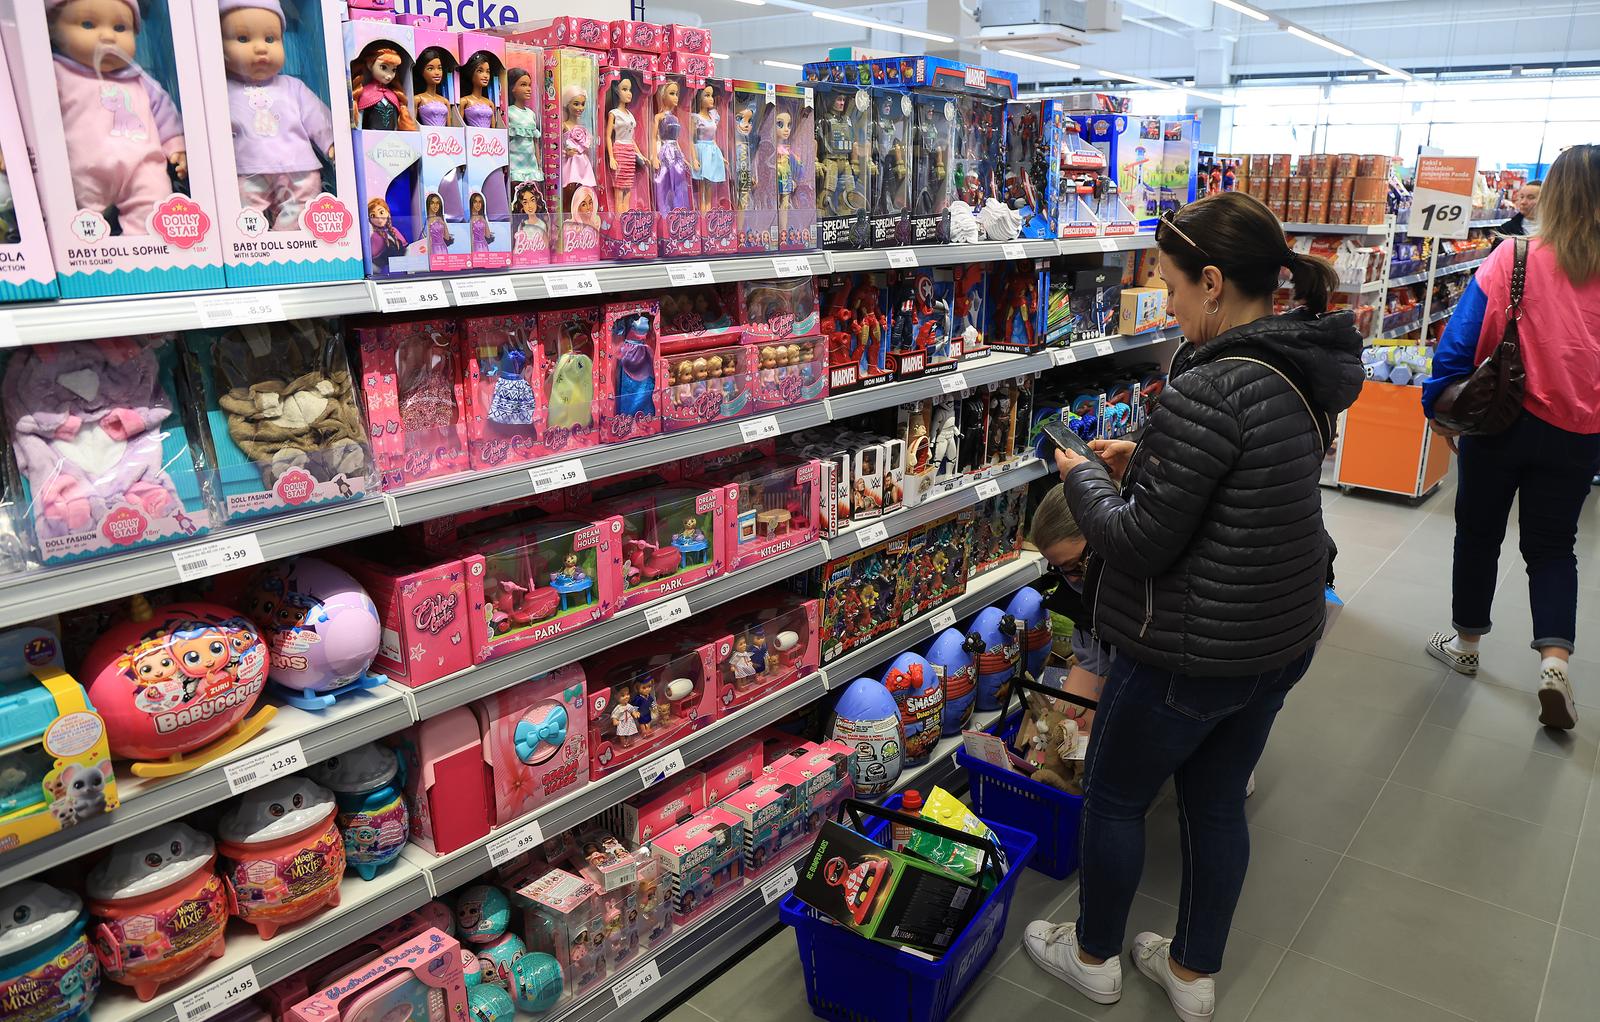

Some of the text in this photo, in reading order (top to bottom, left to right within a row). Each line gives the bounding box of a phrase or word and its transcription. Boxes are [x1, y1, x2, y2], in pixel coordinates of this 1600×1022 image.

[965, 67, 987, 87] MARVEL
[427, 133, 462, 156] Barbie
[472, 135, 505, 157] Barbie
[376, 149, 411, 159] FROZEN
[161, 213, 200, 226] DOLLY
[312, 212, 344, 223] DOLLY
[916, 218, 937, 229] SPECIAL
[80, 220, 97, 228] TRY
[317, 222, 343, 233] STAR
[823, 219, 850, 231] SPECIAL
[875, 218, 896, 230] SPECIAL
[168, 225, 198, 237] STAR
[823, 230, 837, 242] OPS
[875, 229, 886, 239] OPS
[916, 228, 927, 238] OPS
[233, 240, 318, 252] BABY DOLL SOPHIE
[514, 231, 546, 255] Barbie
[564, 230, 597, 252] Barbie
[68, 245, 170, 259] BABY DOLL SOPHIE
[70, 258, 113, 267] WITH SOUND
[902, 353, 924, 374] MARVEL
[831, 367, 857, 388] MARVEL
[864, 376, 886, 386] IRON MAN
[799, 466, 814, 476] DREAM
[799, 472, 814, 482] HOUSE
[283, 481, 308, 492] DOLLY
[231, 492, 273, 504] DOLL FASHION
[287, 489, 306, 499] STAR
[698, 494, 717, 505] DREAM
[698, 501, 717, 512] HOUSE
[109, 518, 139, 531] DOLLY
[113, 527, 139, 539] STAR
[577, 528, 600, 542] DREAM
[45, 533, 97, 548] DOLL FASHION
[577, 536, 600, 549] HOUSE
[760, 539, 792, 558] KITCHEN
[660, 578, 683, 594] PARK
[534, 622, 563, 641] PARK
[210, 681, 230, 694] ZURU
[809, 852, 823, 873] BUMPER
[817, 839, 829, 854] CARS
